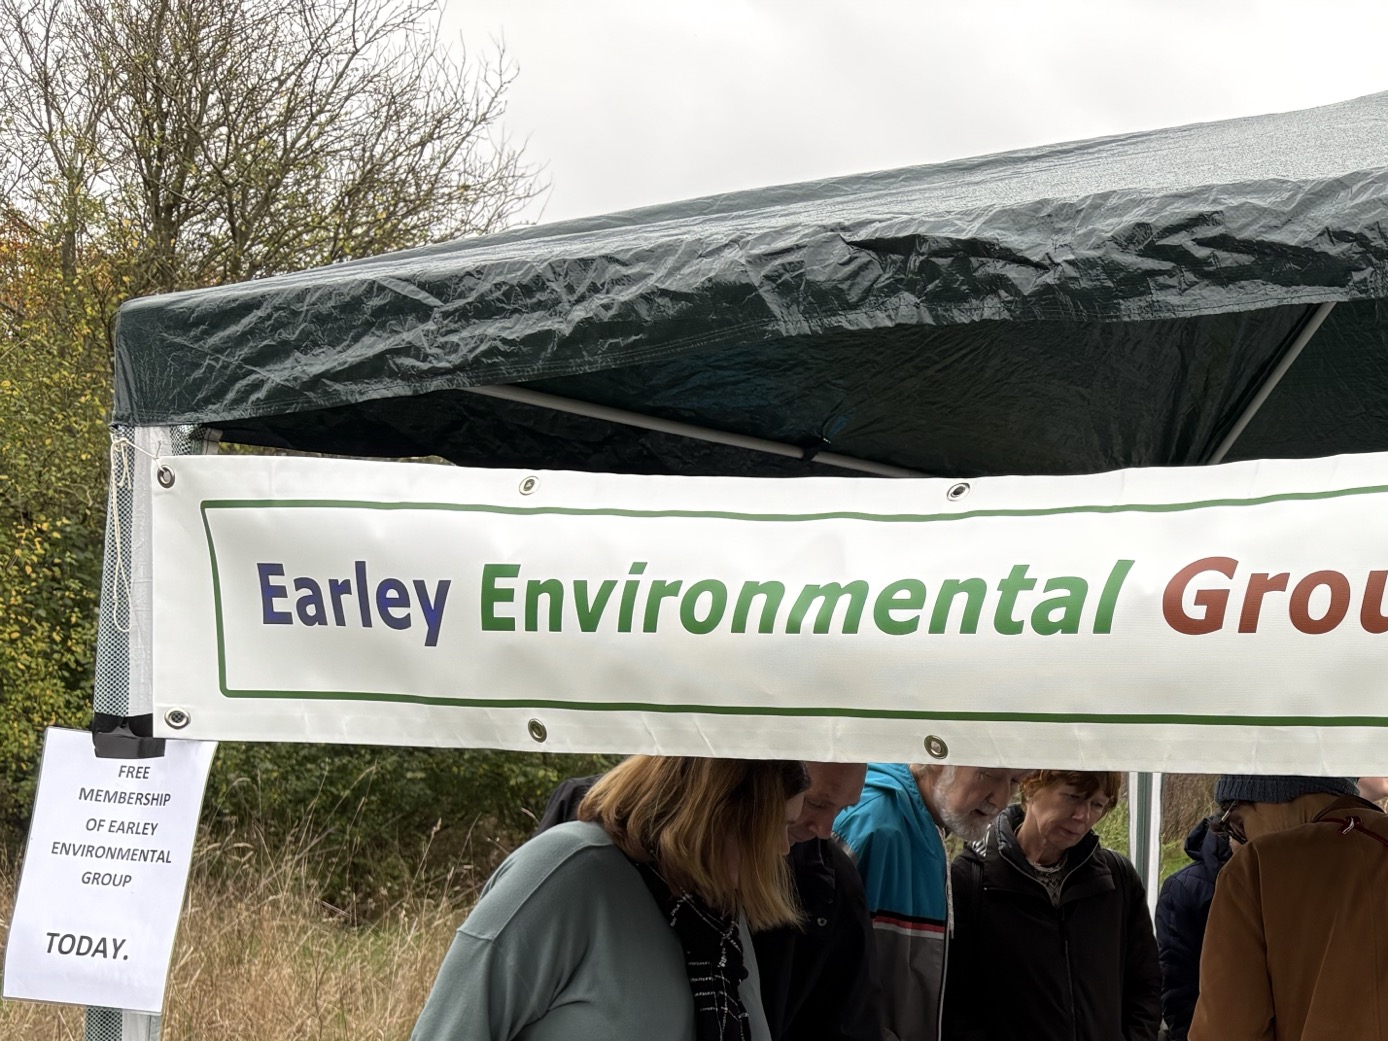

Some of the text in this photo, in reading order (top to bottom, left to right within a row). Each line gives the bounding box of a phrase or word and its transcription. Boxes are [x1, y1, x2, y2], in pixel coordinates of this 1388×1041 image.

[256, 560, 451, 647] Earley
[480, 558, 1136, 636] Environmental
[118, 765, 151, 780] FREE
[78, 787, 171, 807] MEMBERSHIP
[85, 818, 159, 836] OF EARLEY
[51, 841, 172, 864] ENVIRONMENTAL
[81, 871, 132, 888] GROUP
[46, 932, 129, 961] TODAY.
